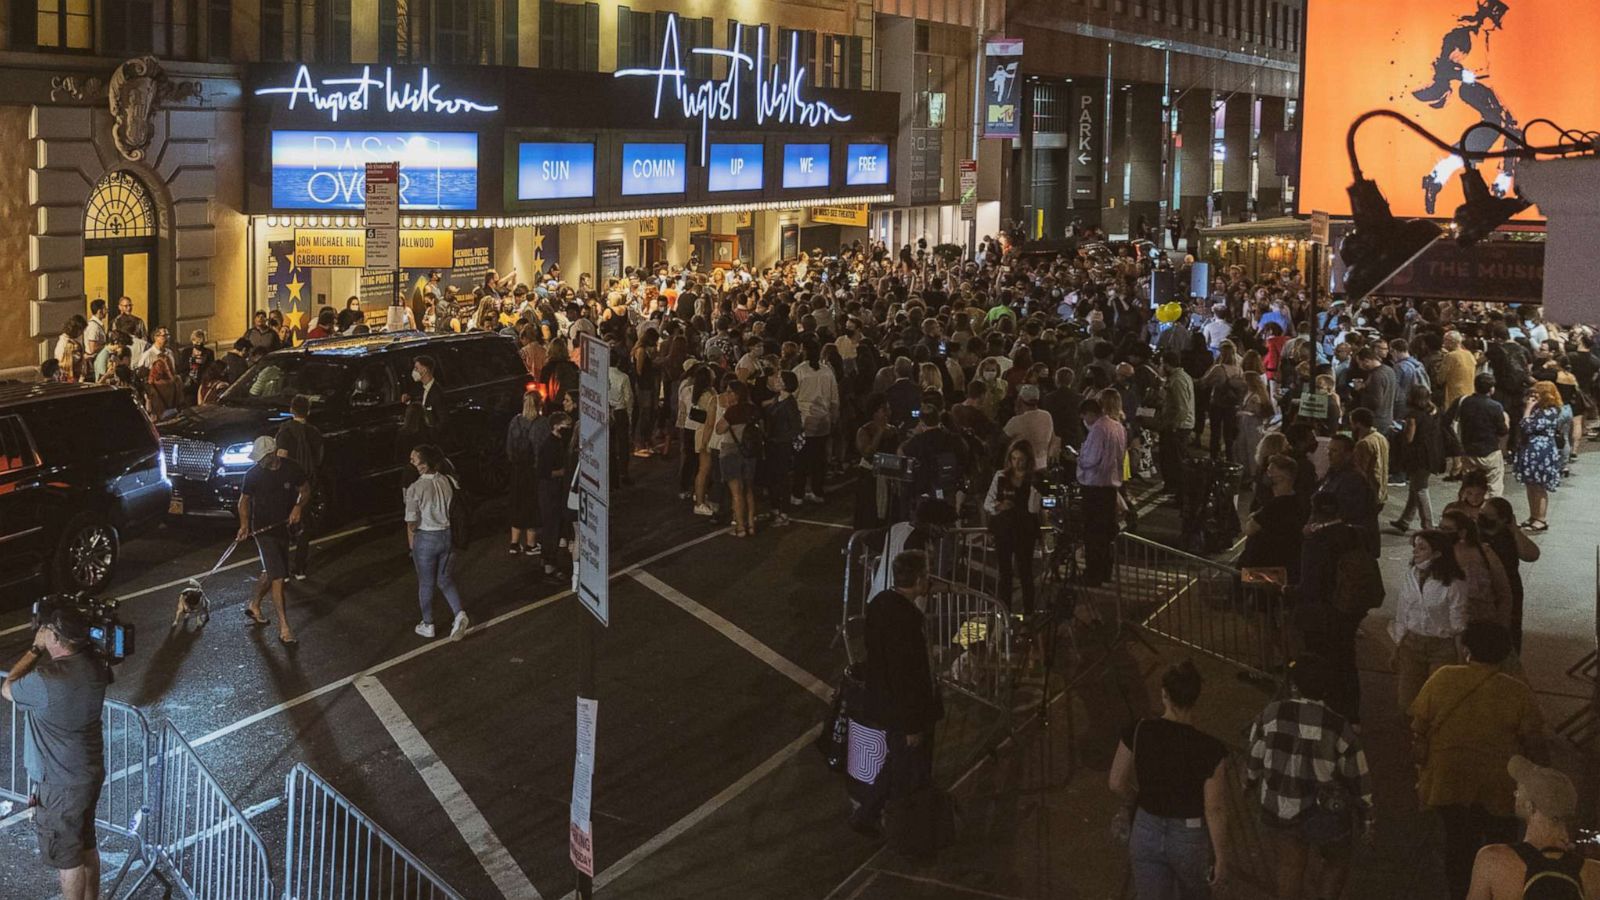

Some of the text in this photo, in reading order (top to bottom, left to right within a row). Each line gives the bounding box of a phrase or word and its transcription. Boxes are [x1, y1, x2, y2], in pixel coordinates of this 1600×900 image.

[255, 65, 499, 122] August Wilson
[613, 13, 852, 168] August Wilson
[988, 104, 1016, 123] MTV
[1079, 95, 1092, 150] PARK
[542, 160, 570, 181] SUN
[632, 159, 676, 179] COMIN
[730, 157, 744, 176] UP
[800, 157, 814, 173] WE
[858, 156, 877, 172] FREE
[308, 171, 409, 203] OVR
[368, 185, 374, 193] 3
[297, 237, 311, 247] JON
[313, 236, 343, 247] MICHAEL
[368, 229, 374, 238] 6
[399, 237, 434, 249] ALLWOOD
[297, 254, 350, 265] GABRIEL EBERT
[1429, 261, 1470, 277] THE
